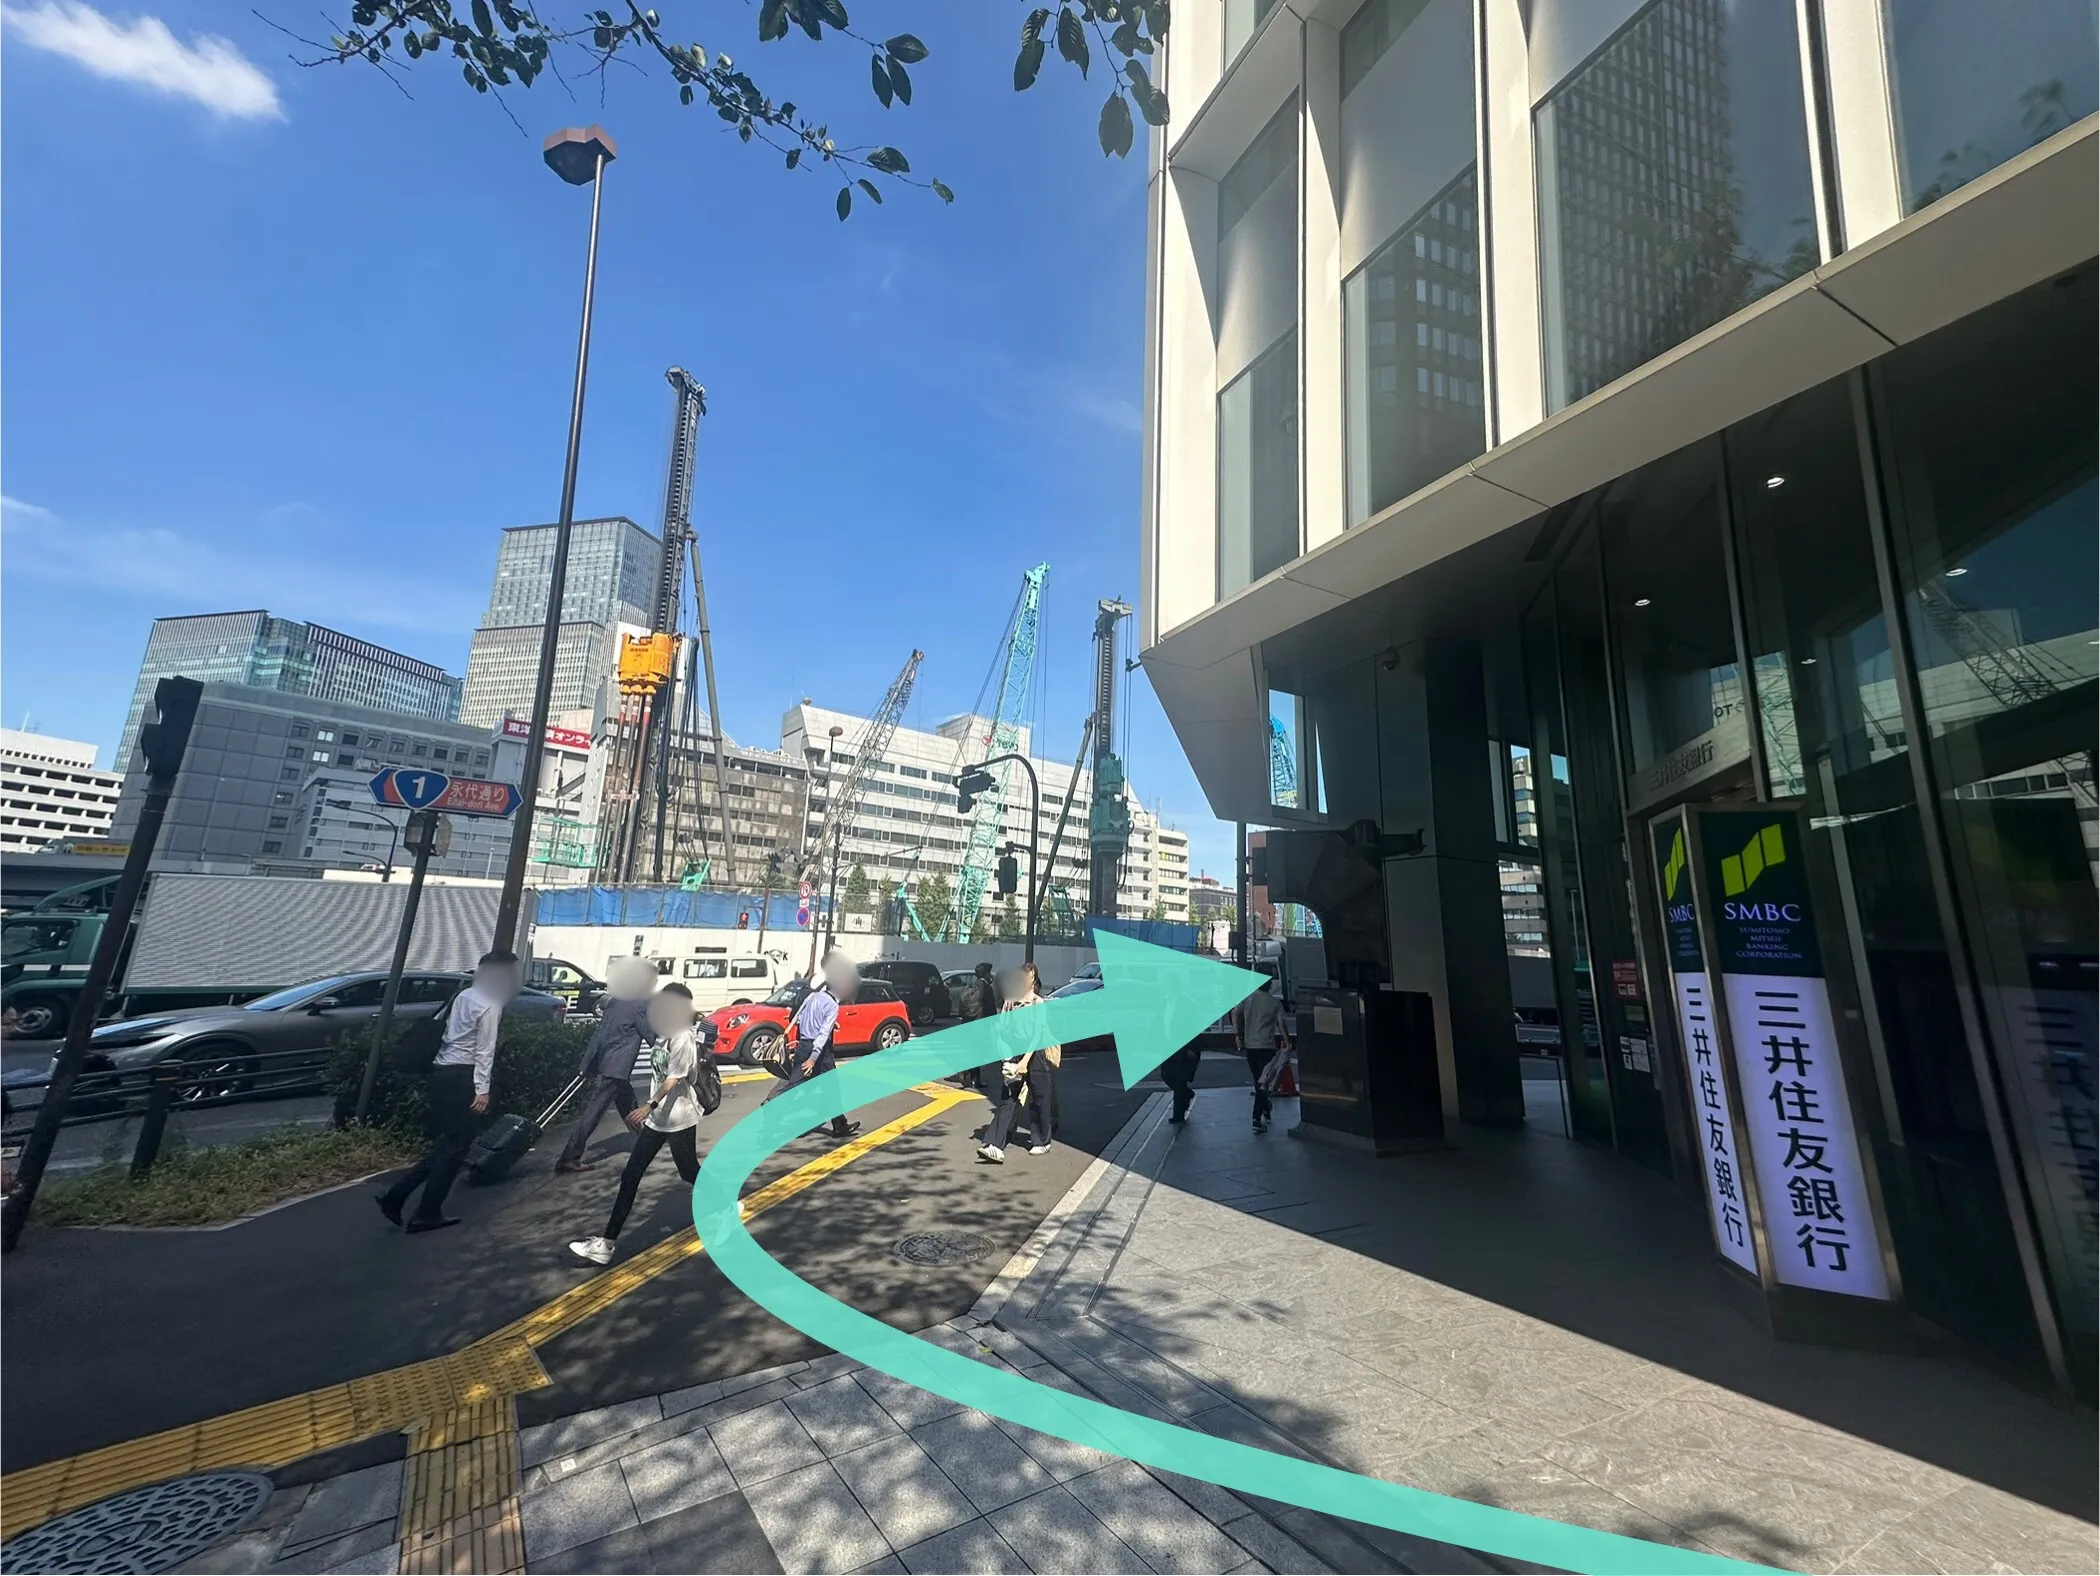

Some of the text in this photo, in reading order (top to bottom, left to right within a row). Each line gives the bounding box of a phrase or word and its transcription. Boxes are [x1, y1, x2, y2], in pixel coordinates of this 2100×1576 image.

[411, 776, 426, 799] 1
[450, 781, 505, 802] 永代通り
[1668, 903, 1696, 923] SMBC
[1723, 902, 1802, 922] SMBC
[1739, 927, 1790, 935] SUMITOMO
[1736, 950, 1803, 959] CORPORATION
[1686, 987, 1744, 1248] 三井住友銀行
[1754, 991, 1851, 1272] 三井住友銀行
